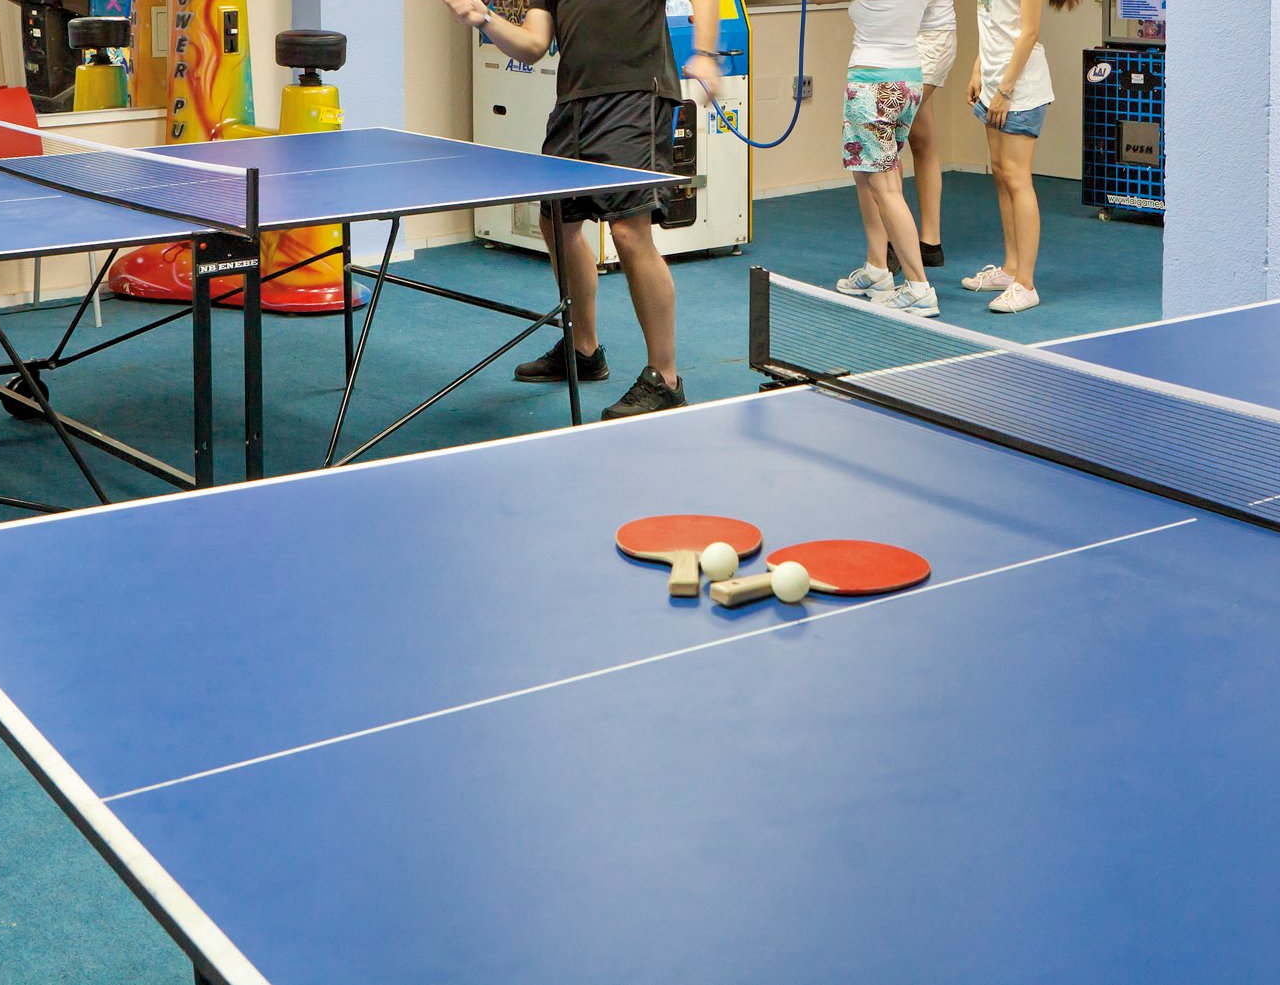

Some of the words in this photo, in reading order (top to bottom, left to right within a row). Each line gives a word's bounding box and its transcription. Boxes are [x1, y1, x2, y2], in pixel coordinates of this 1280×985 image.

[1093, 67, 1107, 78] LAI
[1125, 143, 1154, 155] PUSH
[200, 264, 217, 274] NB
[218, 259, 259, 271] ENEBE
